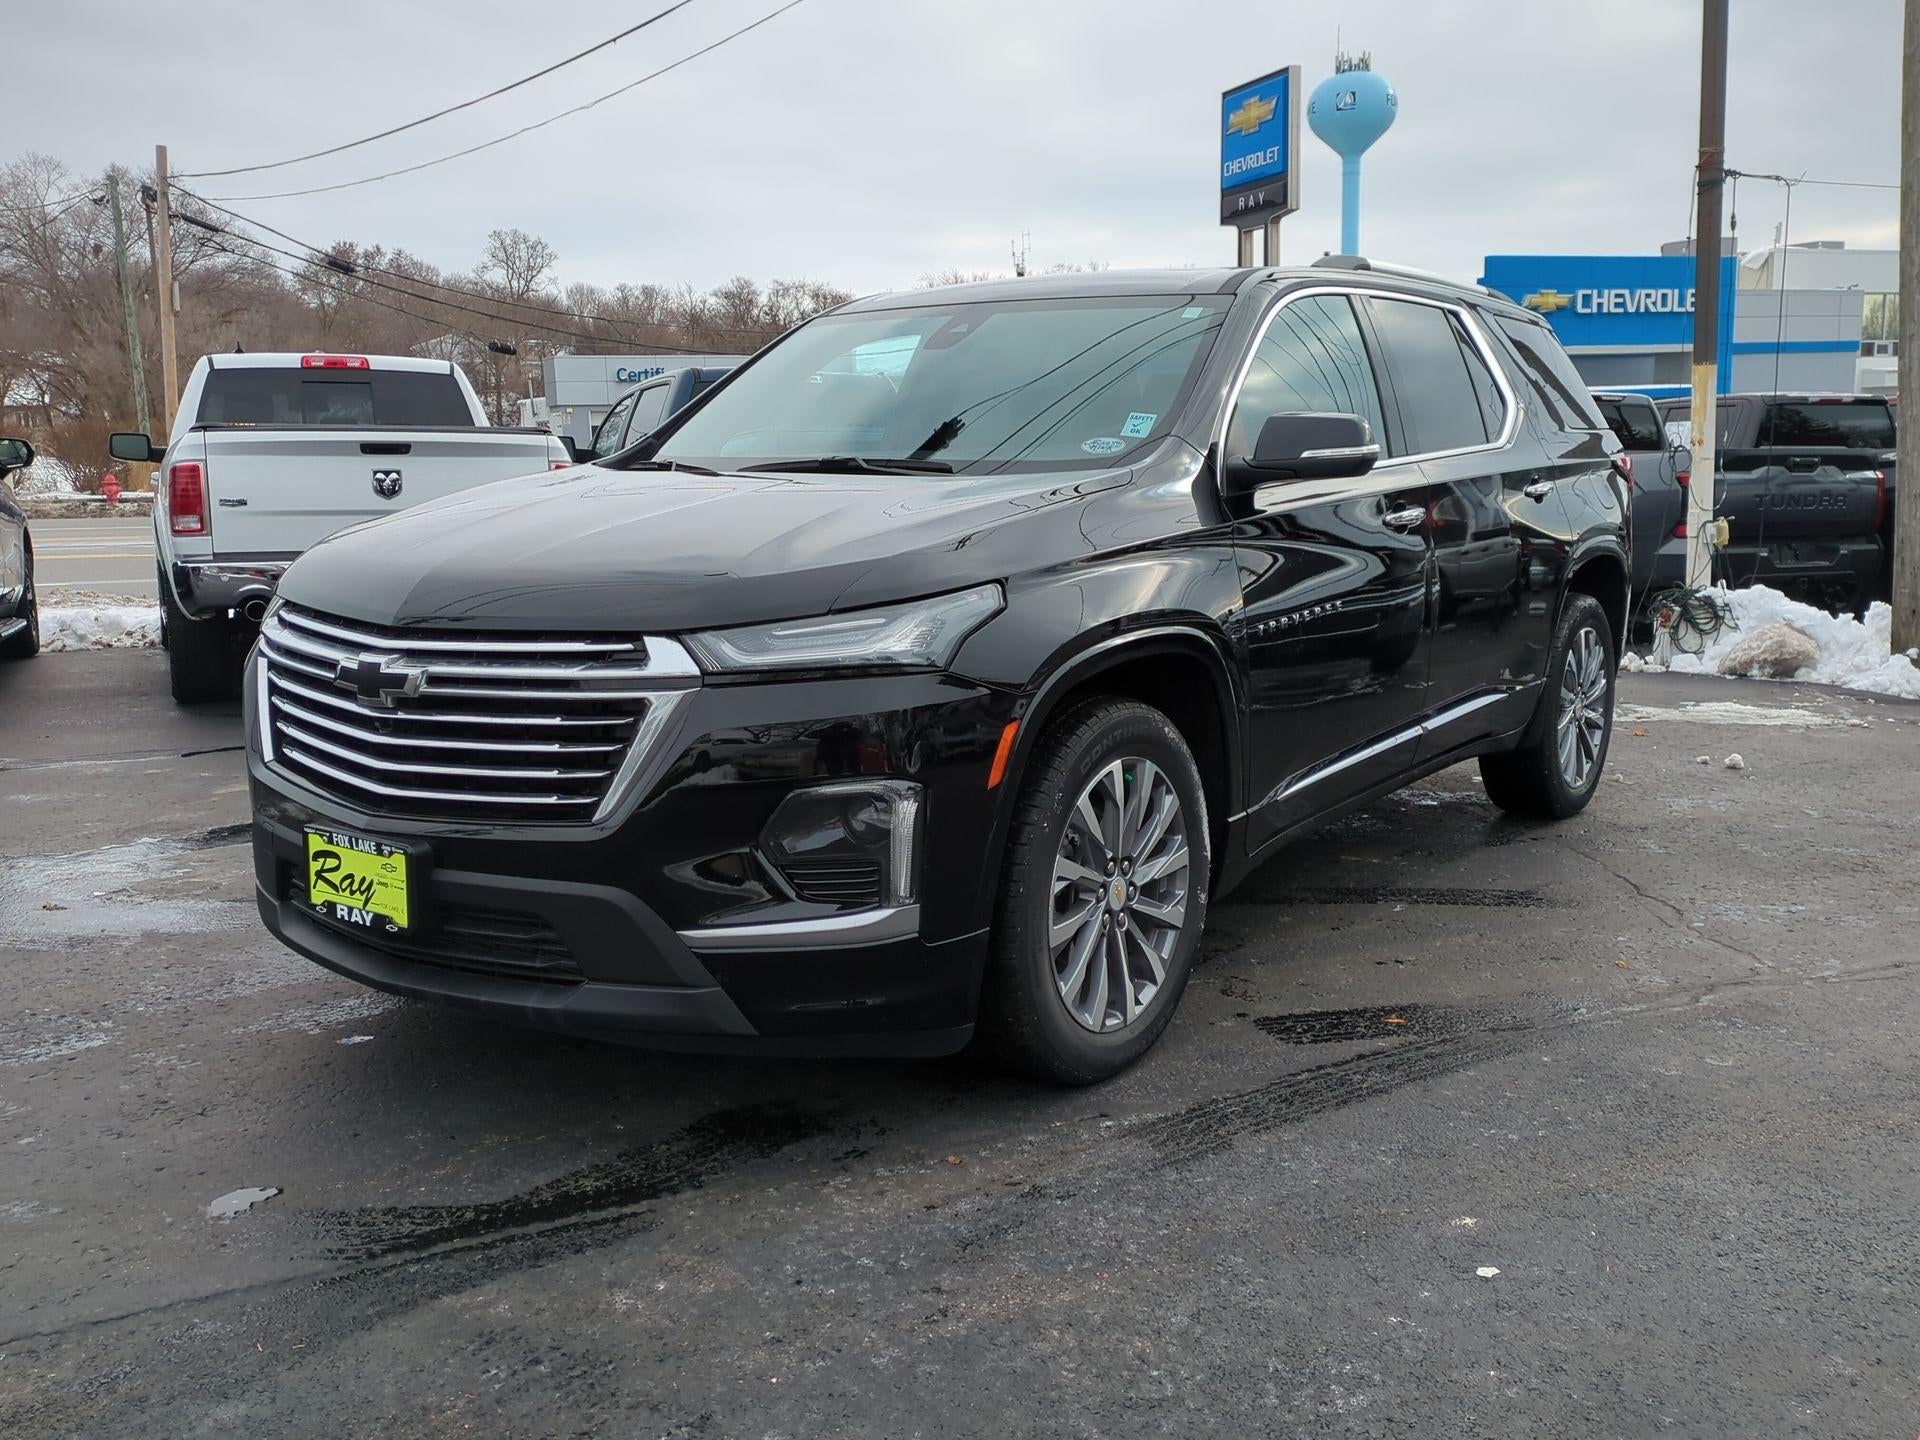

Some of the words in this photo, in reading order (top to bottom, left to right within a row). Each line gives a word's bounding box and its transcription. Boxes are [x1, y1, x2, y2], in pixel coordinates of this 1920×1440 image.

[1224, 146, 1280, 177] CHEVROLET
[1238, 191, 1265, 211] RAY
[1576, 288, 1695, 314] CHEVROLE
[616, 367, 665, 382] Certif
[1753, 494, 1847, 511] TUNDRA
[1257, 601, 1344, 636] TRAVERSE
[332, 832, 350, 849] FOX
[352, 837, 378, 854] LAKE
[311, 849, 376, 910] Ray
[336, 903, 374, 927] RAY
